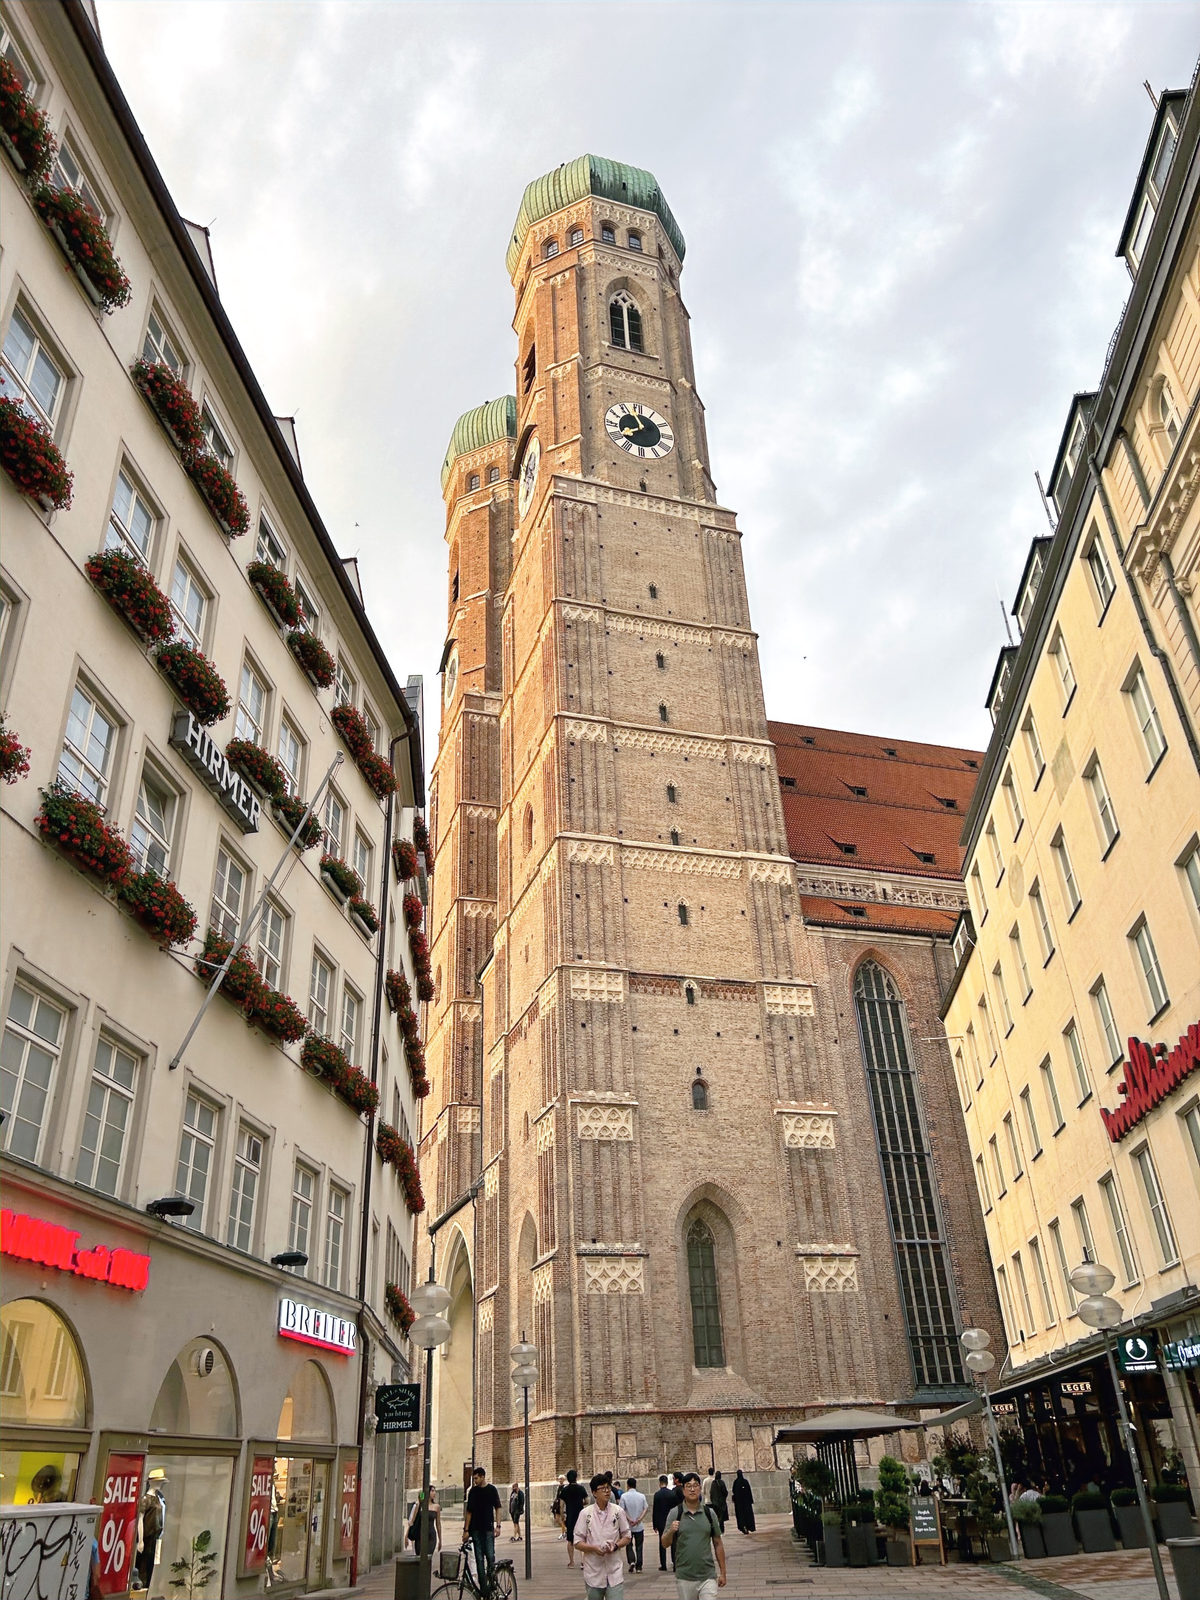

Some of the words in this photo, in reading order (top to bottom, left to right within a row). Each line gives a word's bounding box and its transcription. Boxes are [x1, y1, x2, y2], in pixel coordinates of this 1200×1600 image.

[185, 710, 261, 832] HIRMER
[282, 1299, 357, 1349] BREITER
[1061, 1383, 1091, 1392] LEGER
[991, 1403, 1014, 1412] LEGER
[383, 1420, 413, 1430] HIRMER
[103, 1476, 138, 1504] SALE
[251, 1474, 272, 1497] SALE
[343, 1474, 356, 1493] SALE
[250, 1508, 266, 1552] %
[341, 1502, 353, 1539] %
[102, 1518, 126, 1575] %
